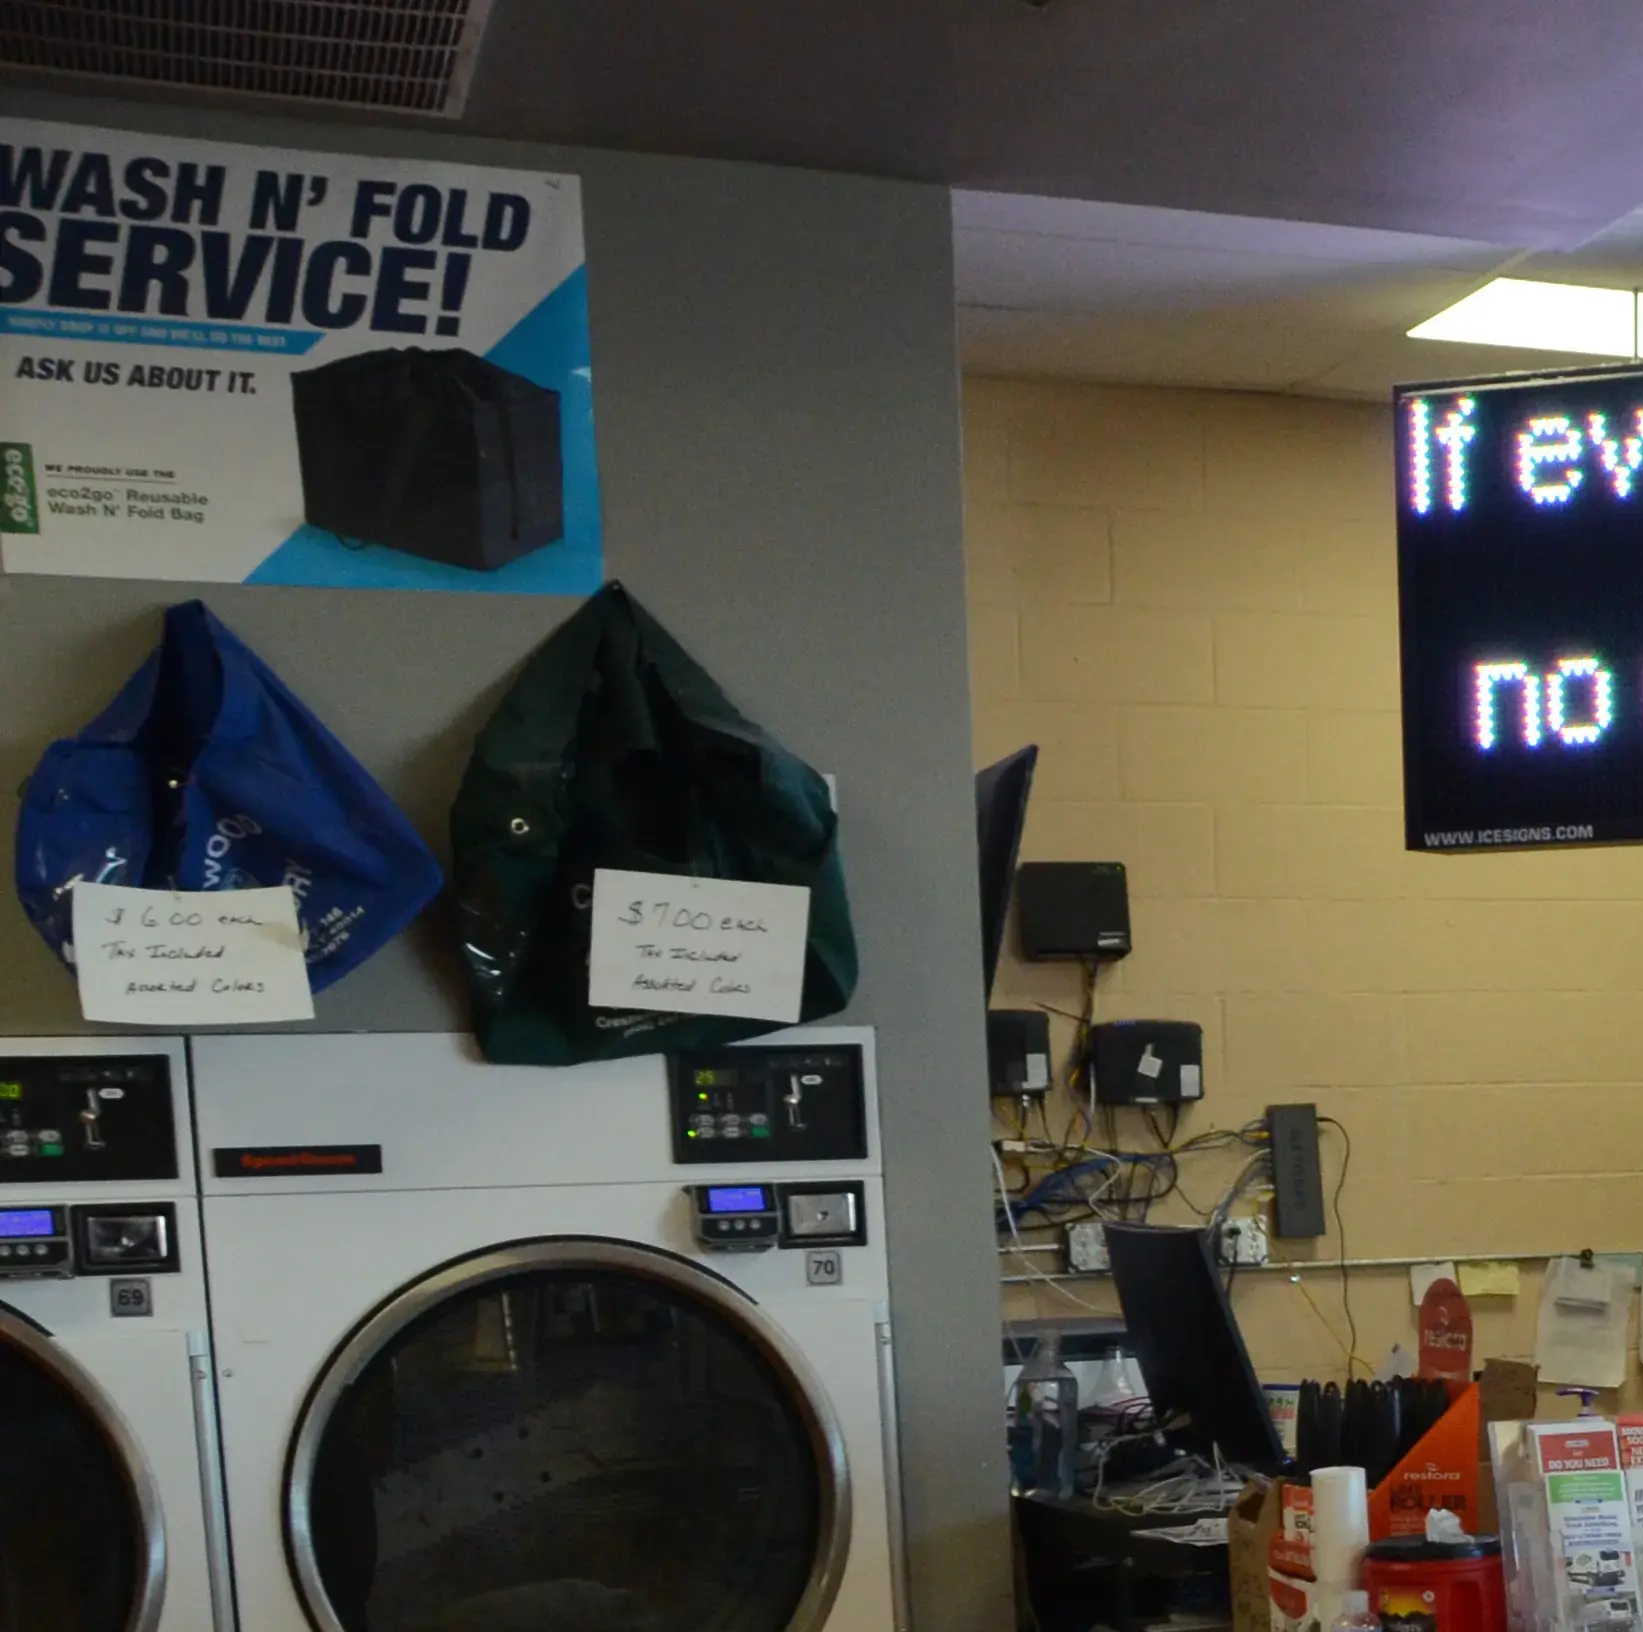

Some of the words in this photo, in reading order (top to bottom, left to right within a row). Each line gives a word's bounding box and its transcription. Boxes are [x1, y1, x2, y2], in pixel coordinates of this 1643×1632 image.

[0, 144, 226, 226] WASH
[350, 179, 532, 253] FOLD
[0, 209, 473, 338] SERVICE!
[15, 357, 76, 382] ASK
[83, 360, 120, 386] US
[126, 365, 220, 393] ABOUT
[227, 371, 256, 394] IT.
[1409, 398, 1478, 515] If
[126, 489, 209, 506] Reusable
[48, 502, 96, 516] Wash
[127, 504, 164, 520] Fold
[171, 506, 205, 524] Bag
[1473, 656, 1615, 751] no
[1424, 824, 1593, 847] WWW.ICESIGNS.COM
[813, 1260, 834, 1275] 70
[118, 1289, 144, 1306] 69
[1566, 1460, 1583, 1468] YOU
[1584, 1459, 1609, 1467] NEED
[1404, 1470, 1461, 1480] restora
